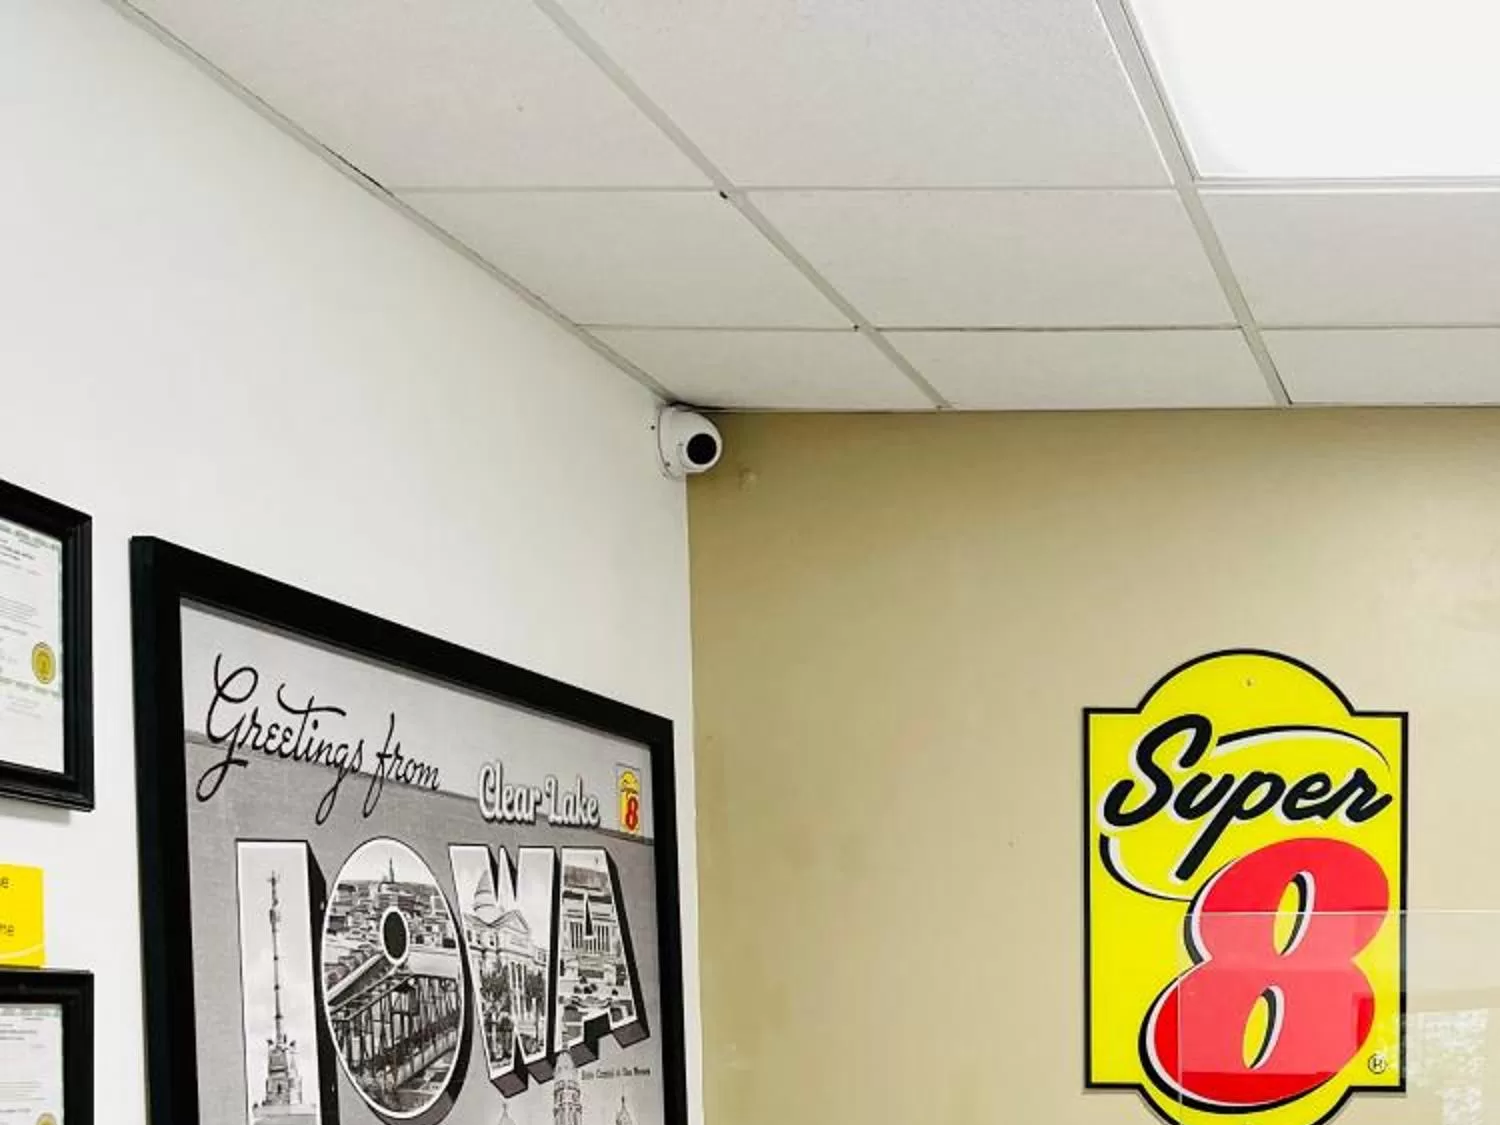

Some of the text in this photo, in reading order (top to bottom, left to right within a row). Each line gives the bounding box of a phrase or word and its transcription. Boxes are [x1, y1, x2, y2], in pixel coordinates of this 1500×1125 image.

[195, 652, 441, 826] Greetings from
[478, 761, 600, 827] Clear Lake
[1100, 712, 1394, 886] Super
[1137, 836, 1391, 1115] 8
